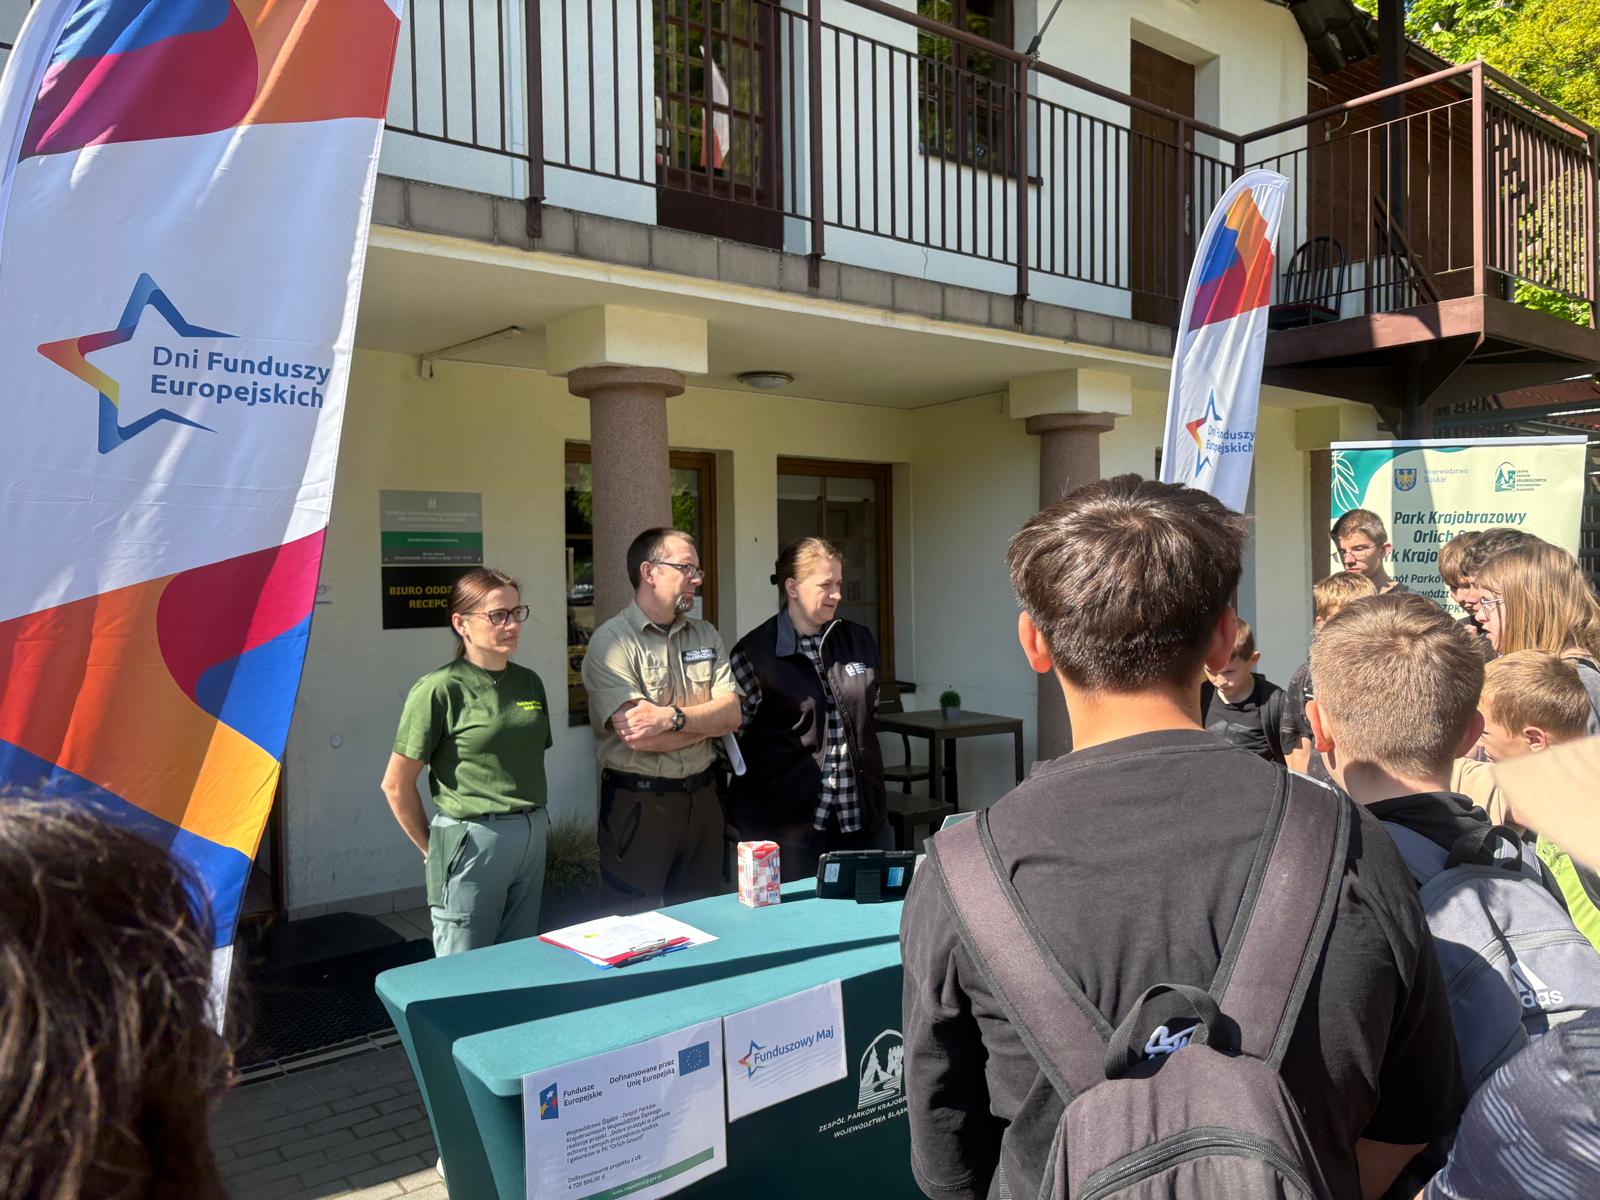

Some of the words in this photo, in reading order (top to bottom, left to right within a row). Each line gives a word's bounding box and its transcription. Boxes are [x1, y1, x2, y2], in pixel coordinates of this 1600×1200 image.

[152, 346, 198, 370] Dni
[207, 352, 330, 385] Funduszy
[151, 374, 323, 408] Europejskich
[1393, 511, 1426, 524] Park
[1428, 510, 1527, 525] Krajobrazowy
[1413, 529, 1454, 543] Orlich
[1402, 549, 1439, 564] Krajo
[1411, 574, 1446, 584] Parkó
[389, 585, 423, 595] BIURO
[425, 585, 453, 595] ODDZ
[409, 599, 448, 609] RECEPC
[1521, 990, 1563, 1008] das
[754, 1034, 815, 1064] Funduszowy
[816, 1026, 834, 1043] Maj
[609, 1065, 657, 1085] Dofinansowane
[658, 1059, 675, 1071] przez
[626, 1078, 641, 1088] Unię
[642, 1067, 675, 1083] Europejską
[563, 1083, 595, 1098] Fundusze
[563, 1090, 603, 1107] Europejskie
[818, 1116, 846, 1132] ZESPÓŁ
[847, 1106, 877, 1121] PARKÓW
[877, 1096, 908, 1110] KRAJOBR
[833, 1114, 887, 1138] WOJEWÓDZTWA
[887, 1106, 909, 1119] ŚLĄSK
